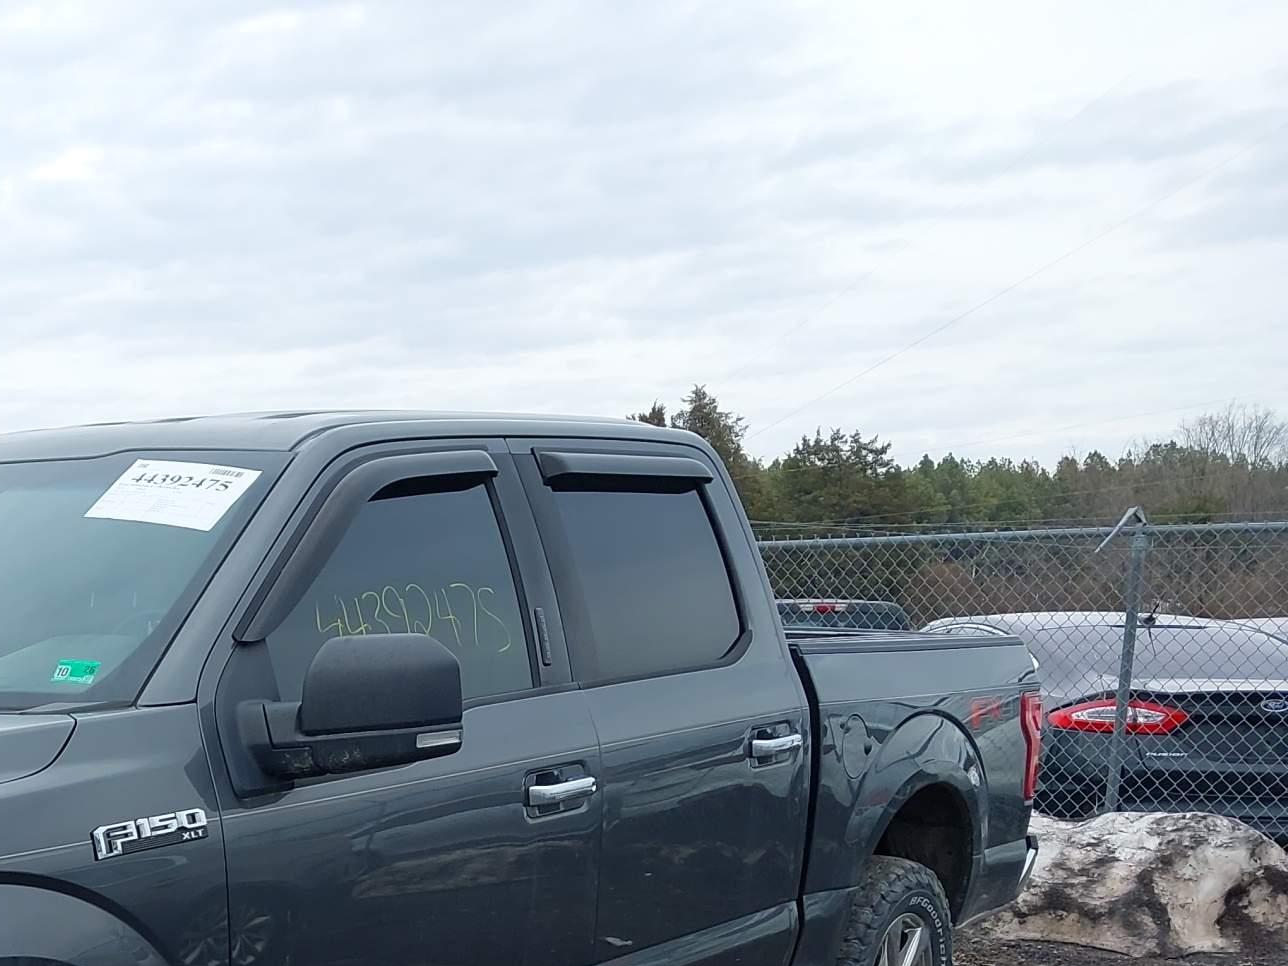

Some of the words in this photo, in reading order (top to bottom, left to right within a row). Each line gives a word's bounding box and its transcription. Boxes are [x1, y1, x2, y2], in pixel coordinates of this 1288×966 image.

[132, 472, 234, 492] 44392475
[316, 583, 512, 653] 44392475
[57, 667, 69, 677] 10
[182, 829, 205, 841] XLT
